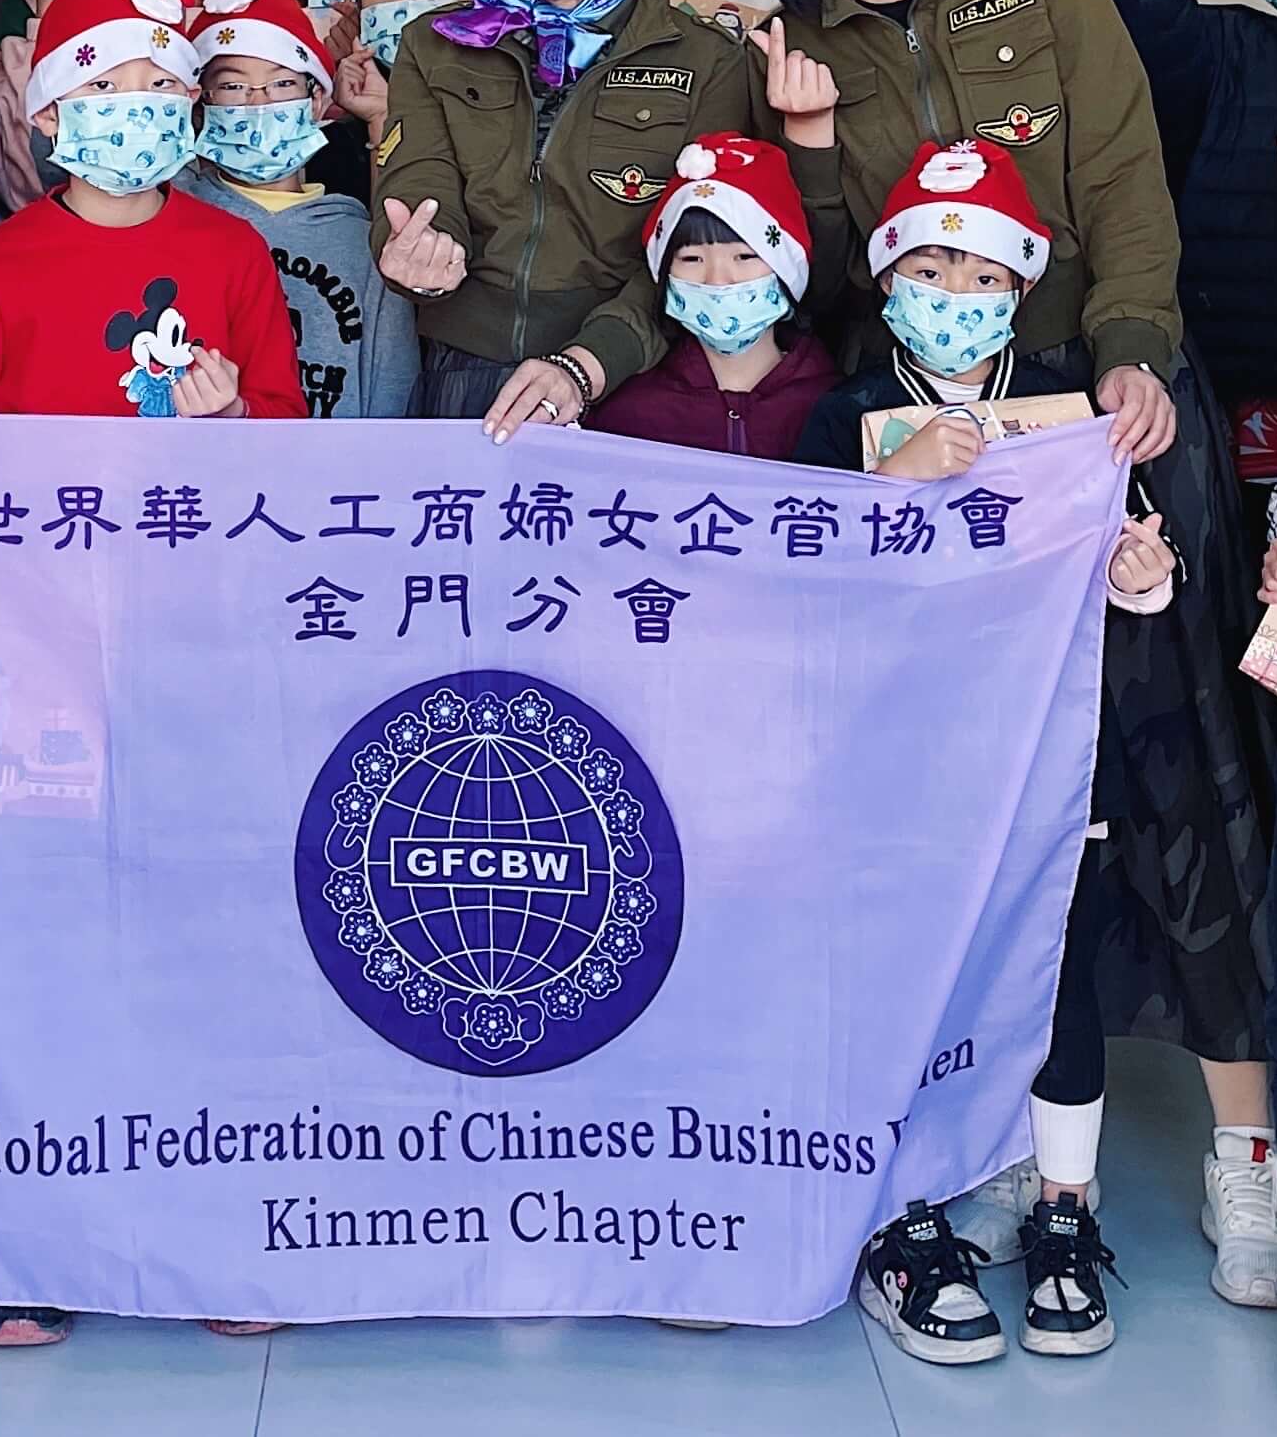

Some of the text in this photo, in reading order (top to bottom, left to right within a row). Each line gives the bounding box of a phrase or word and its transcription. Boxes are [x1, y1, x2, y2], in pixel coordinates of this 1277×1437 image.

[610, 69, 689, 88] U.S.ARMY
[286, 575, 690, 643] 金門分會
[407, 847, 569, 883] GFCBW
[122, 1106, 384, 1170] Federation
[399, 1111, 452, 1161] of
[461, 1111, 654, 1162] Chinese
[667, 1107, 875, 1175] Business
[263, 1190, 744, 1260] Kinmen Chapter
